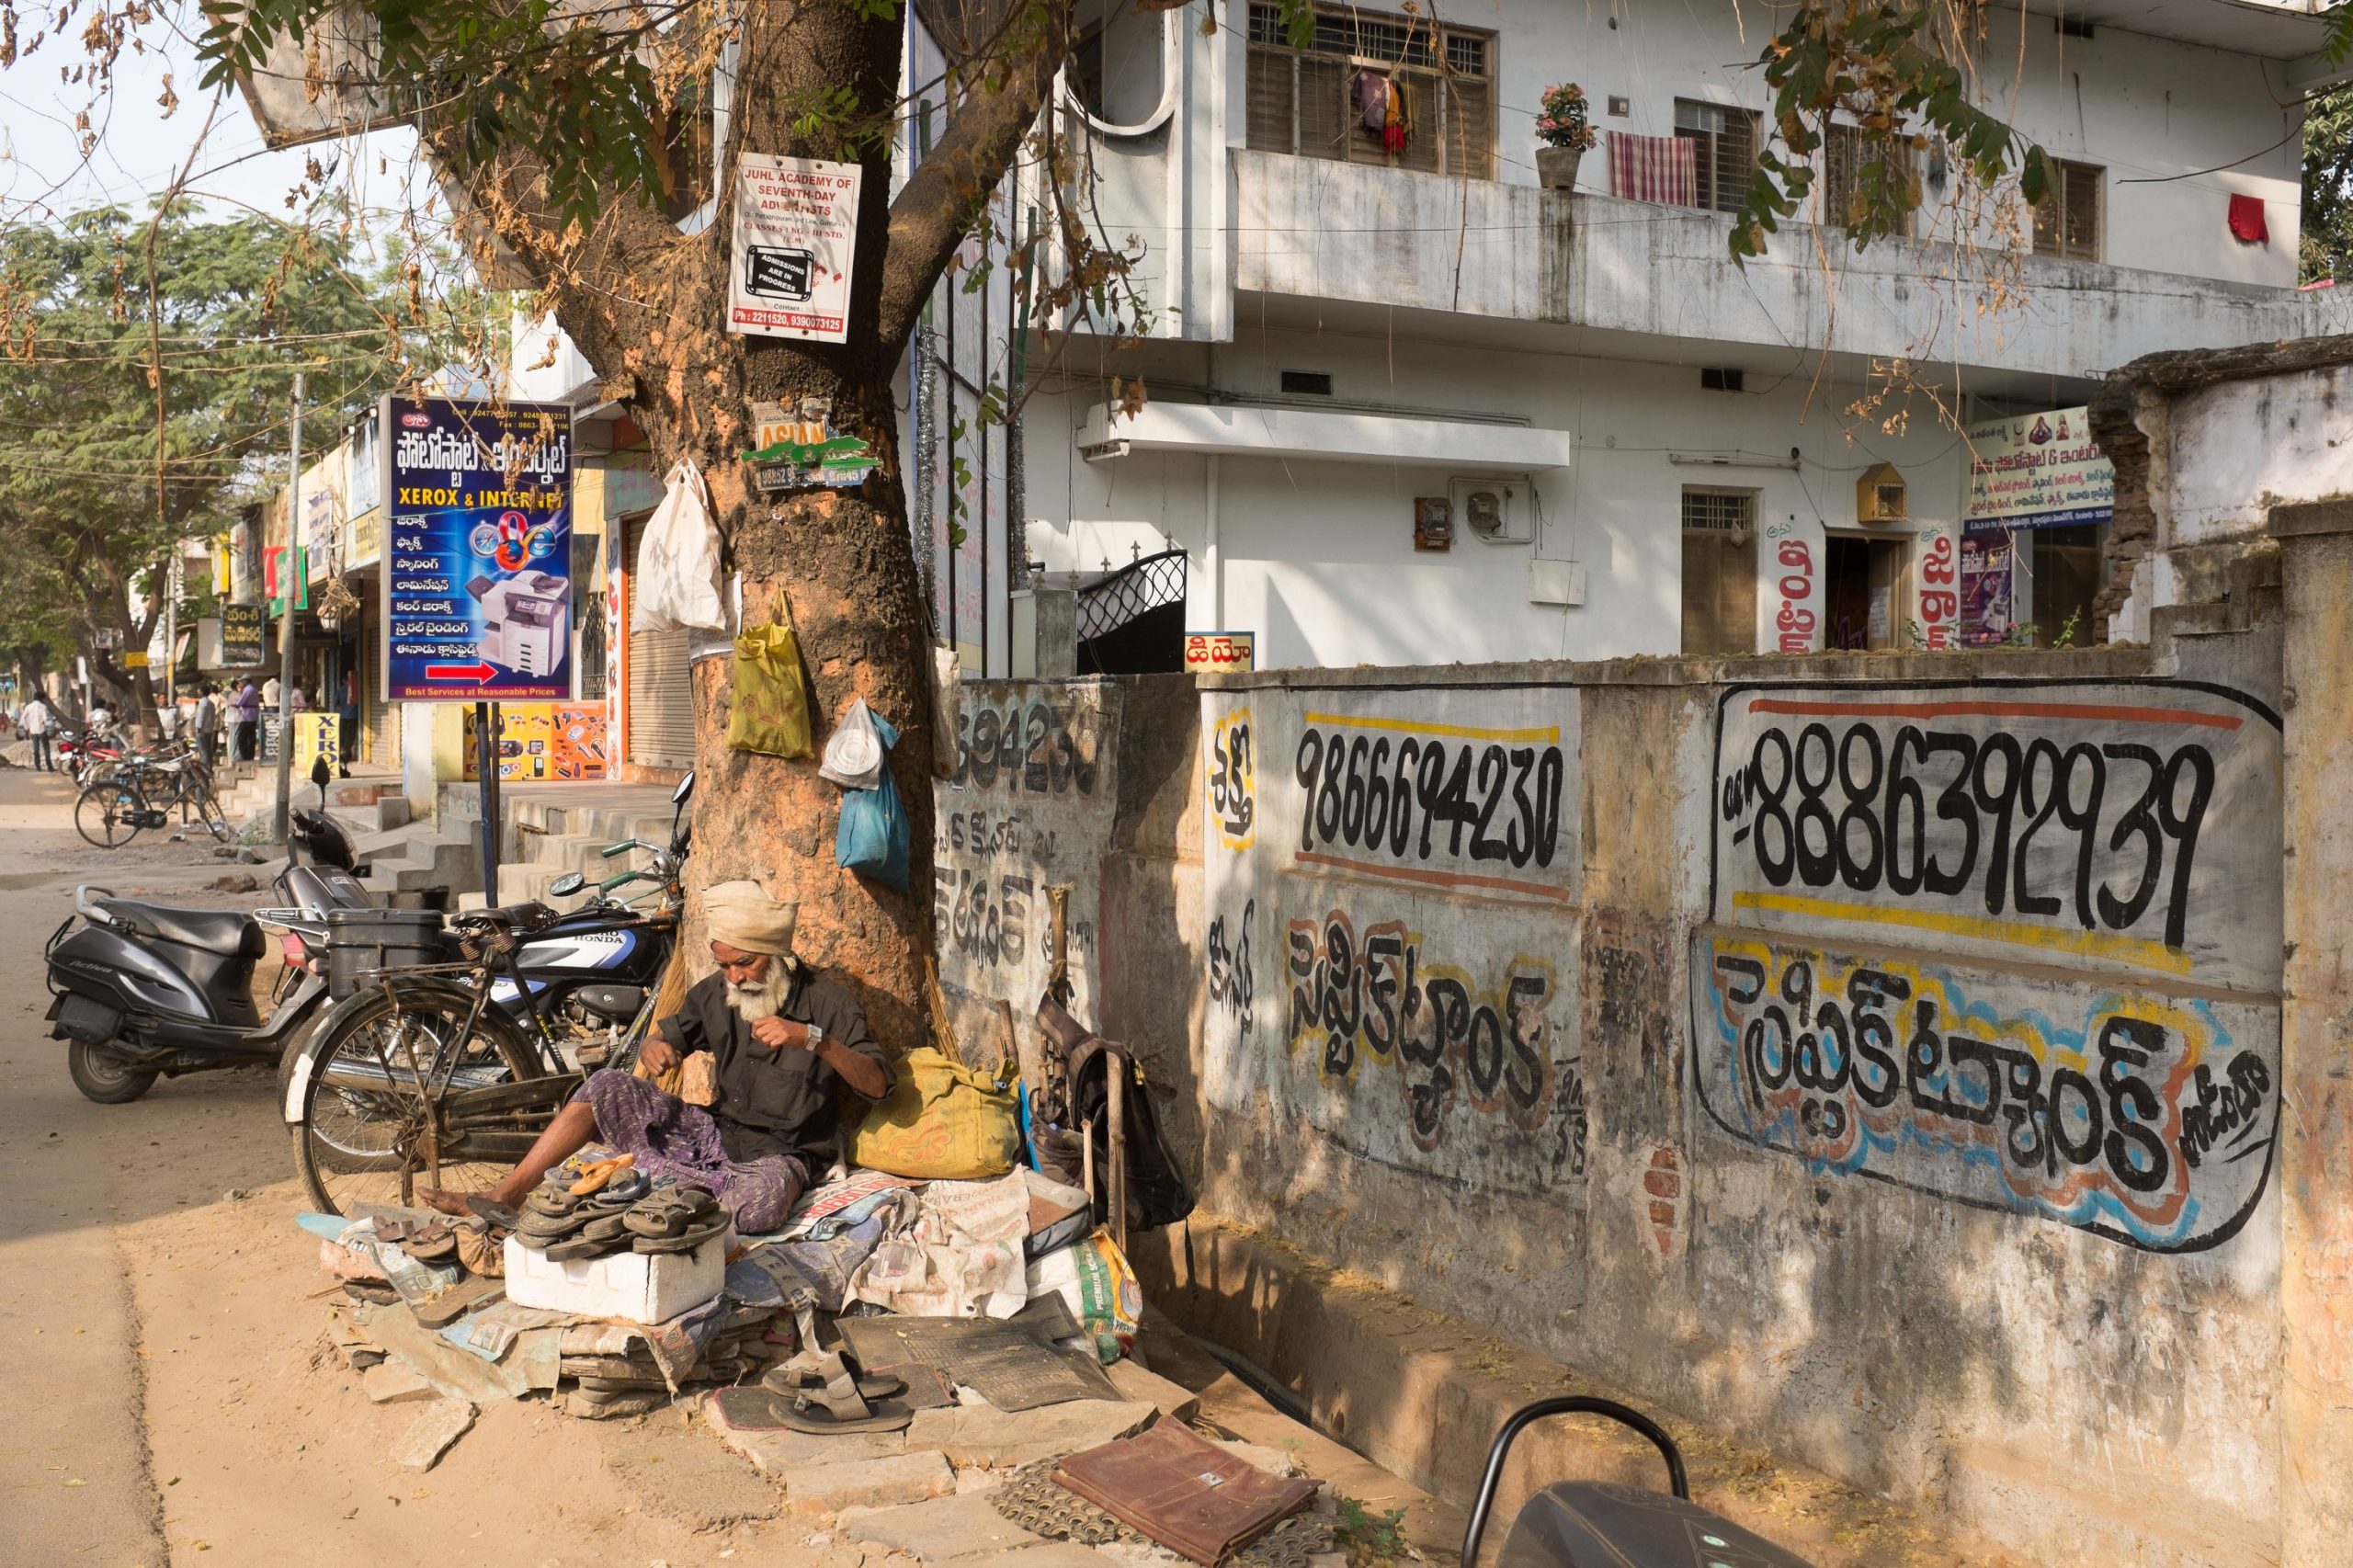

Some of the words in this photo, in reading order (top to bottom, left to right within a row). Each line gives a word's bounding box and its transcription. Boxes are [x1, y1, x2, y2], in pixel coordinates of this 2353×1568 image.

[745, 169, 775, 182] JUHL
[779, 173, 833, 187] ACADEMY
[836, 177, 852, 189] OF
[758, 185, 836, 201] SEVENTH-DAY
[744, 222, 783, 233] CLASSES
[761, 254, 805, 276] ADMISSIONS
[767, 267, 783, 278] ARE
[783, 271, 792, 280] IN
[758, 274, 796, 292] PROGRESS
[774, 303, 800, 312] Contact
[752, 313, 790, 327] 2211520,
[790, 315, 840, 330] 9390073125
[399, 487, 458, 506] XEROX
[464, 494, 474, 507] &
[396, 600, 420, 612] కలర్
[405, 687, 426, 697] Best
[427, 687, 465, 697] Services
[467, 688, 475, 697] at
[477, 687, 527, 697] Reasonable
[529, 687, 556, 697] Prices
[1296, 728, 1564, 869] 9866694230
[1752, 722, 2216, 954] 8886392939
[574, 935, 624, 944] HONDA
[69, 960, 114, 973] Activa
[1089, 1272, 1106, 1311] PREMIUM
